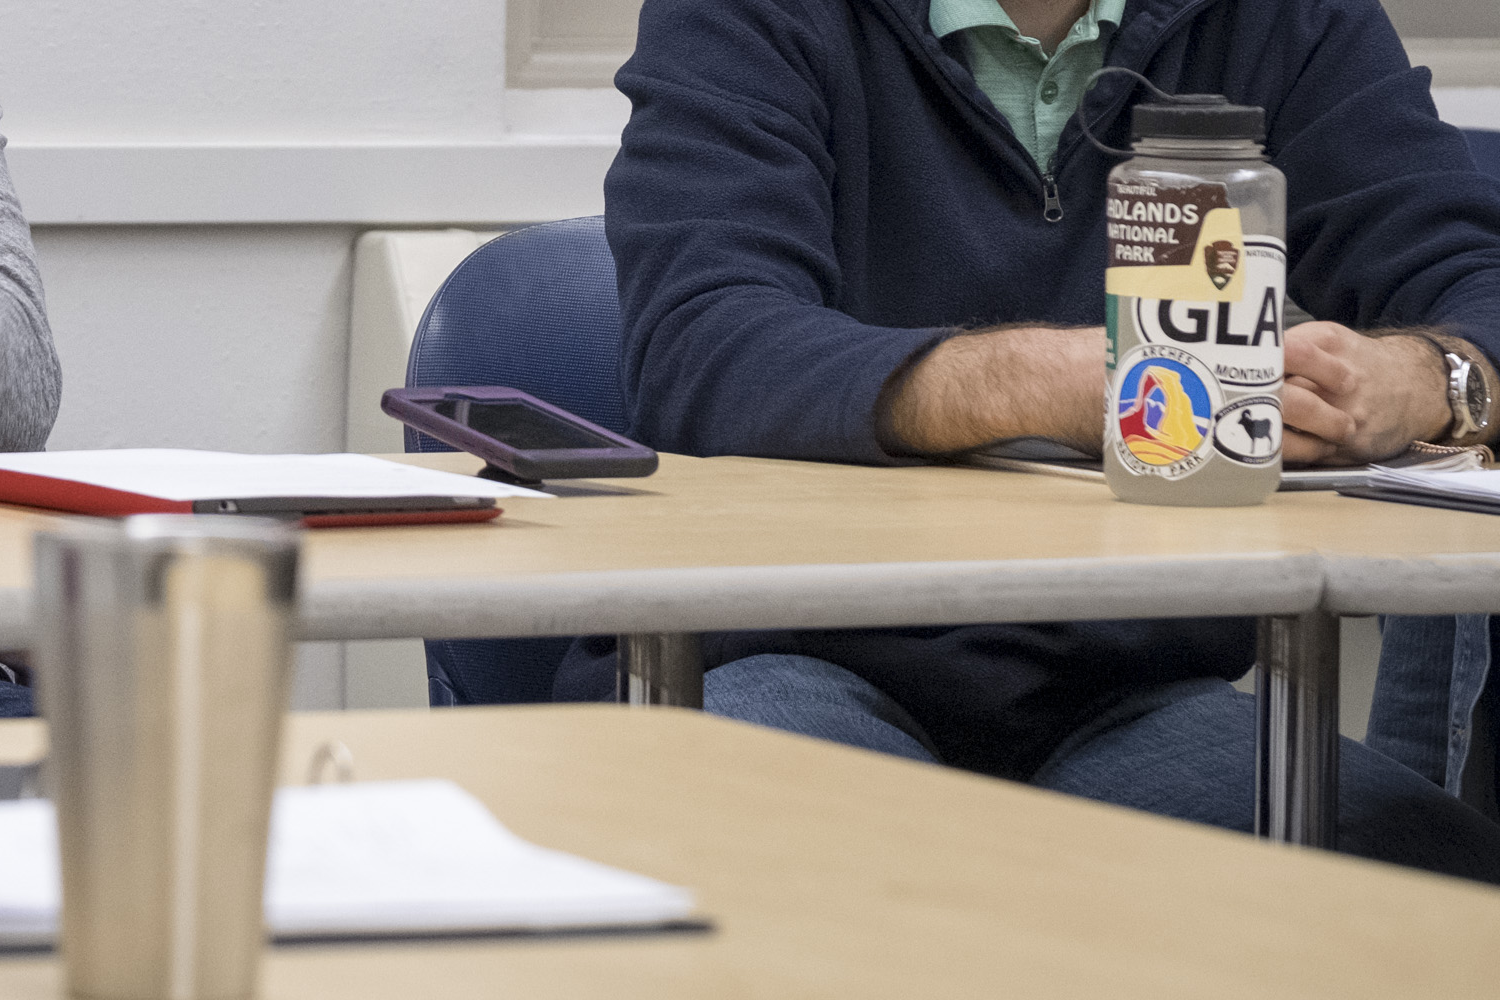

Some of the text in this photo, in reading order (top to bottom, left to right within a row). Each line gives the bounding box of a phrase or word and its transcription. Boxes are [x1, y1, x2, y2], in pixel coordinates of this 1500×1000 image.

[1107, 198, 1199, 225] ADLANDS
[1108, 222, 1179, 244] NATIONAL
[1115, 243, 1155, 263] PARK
[1141, 346, 1193, 366] ARCHES
[1215, 364, 1276, 381] MONTANA
[1169, 453, 1204, 477] PARK
